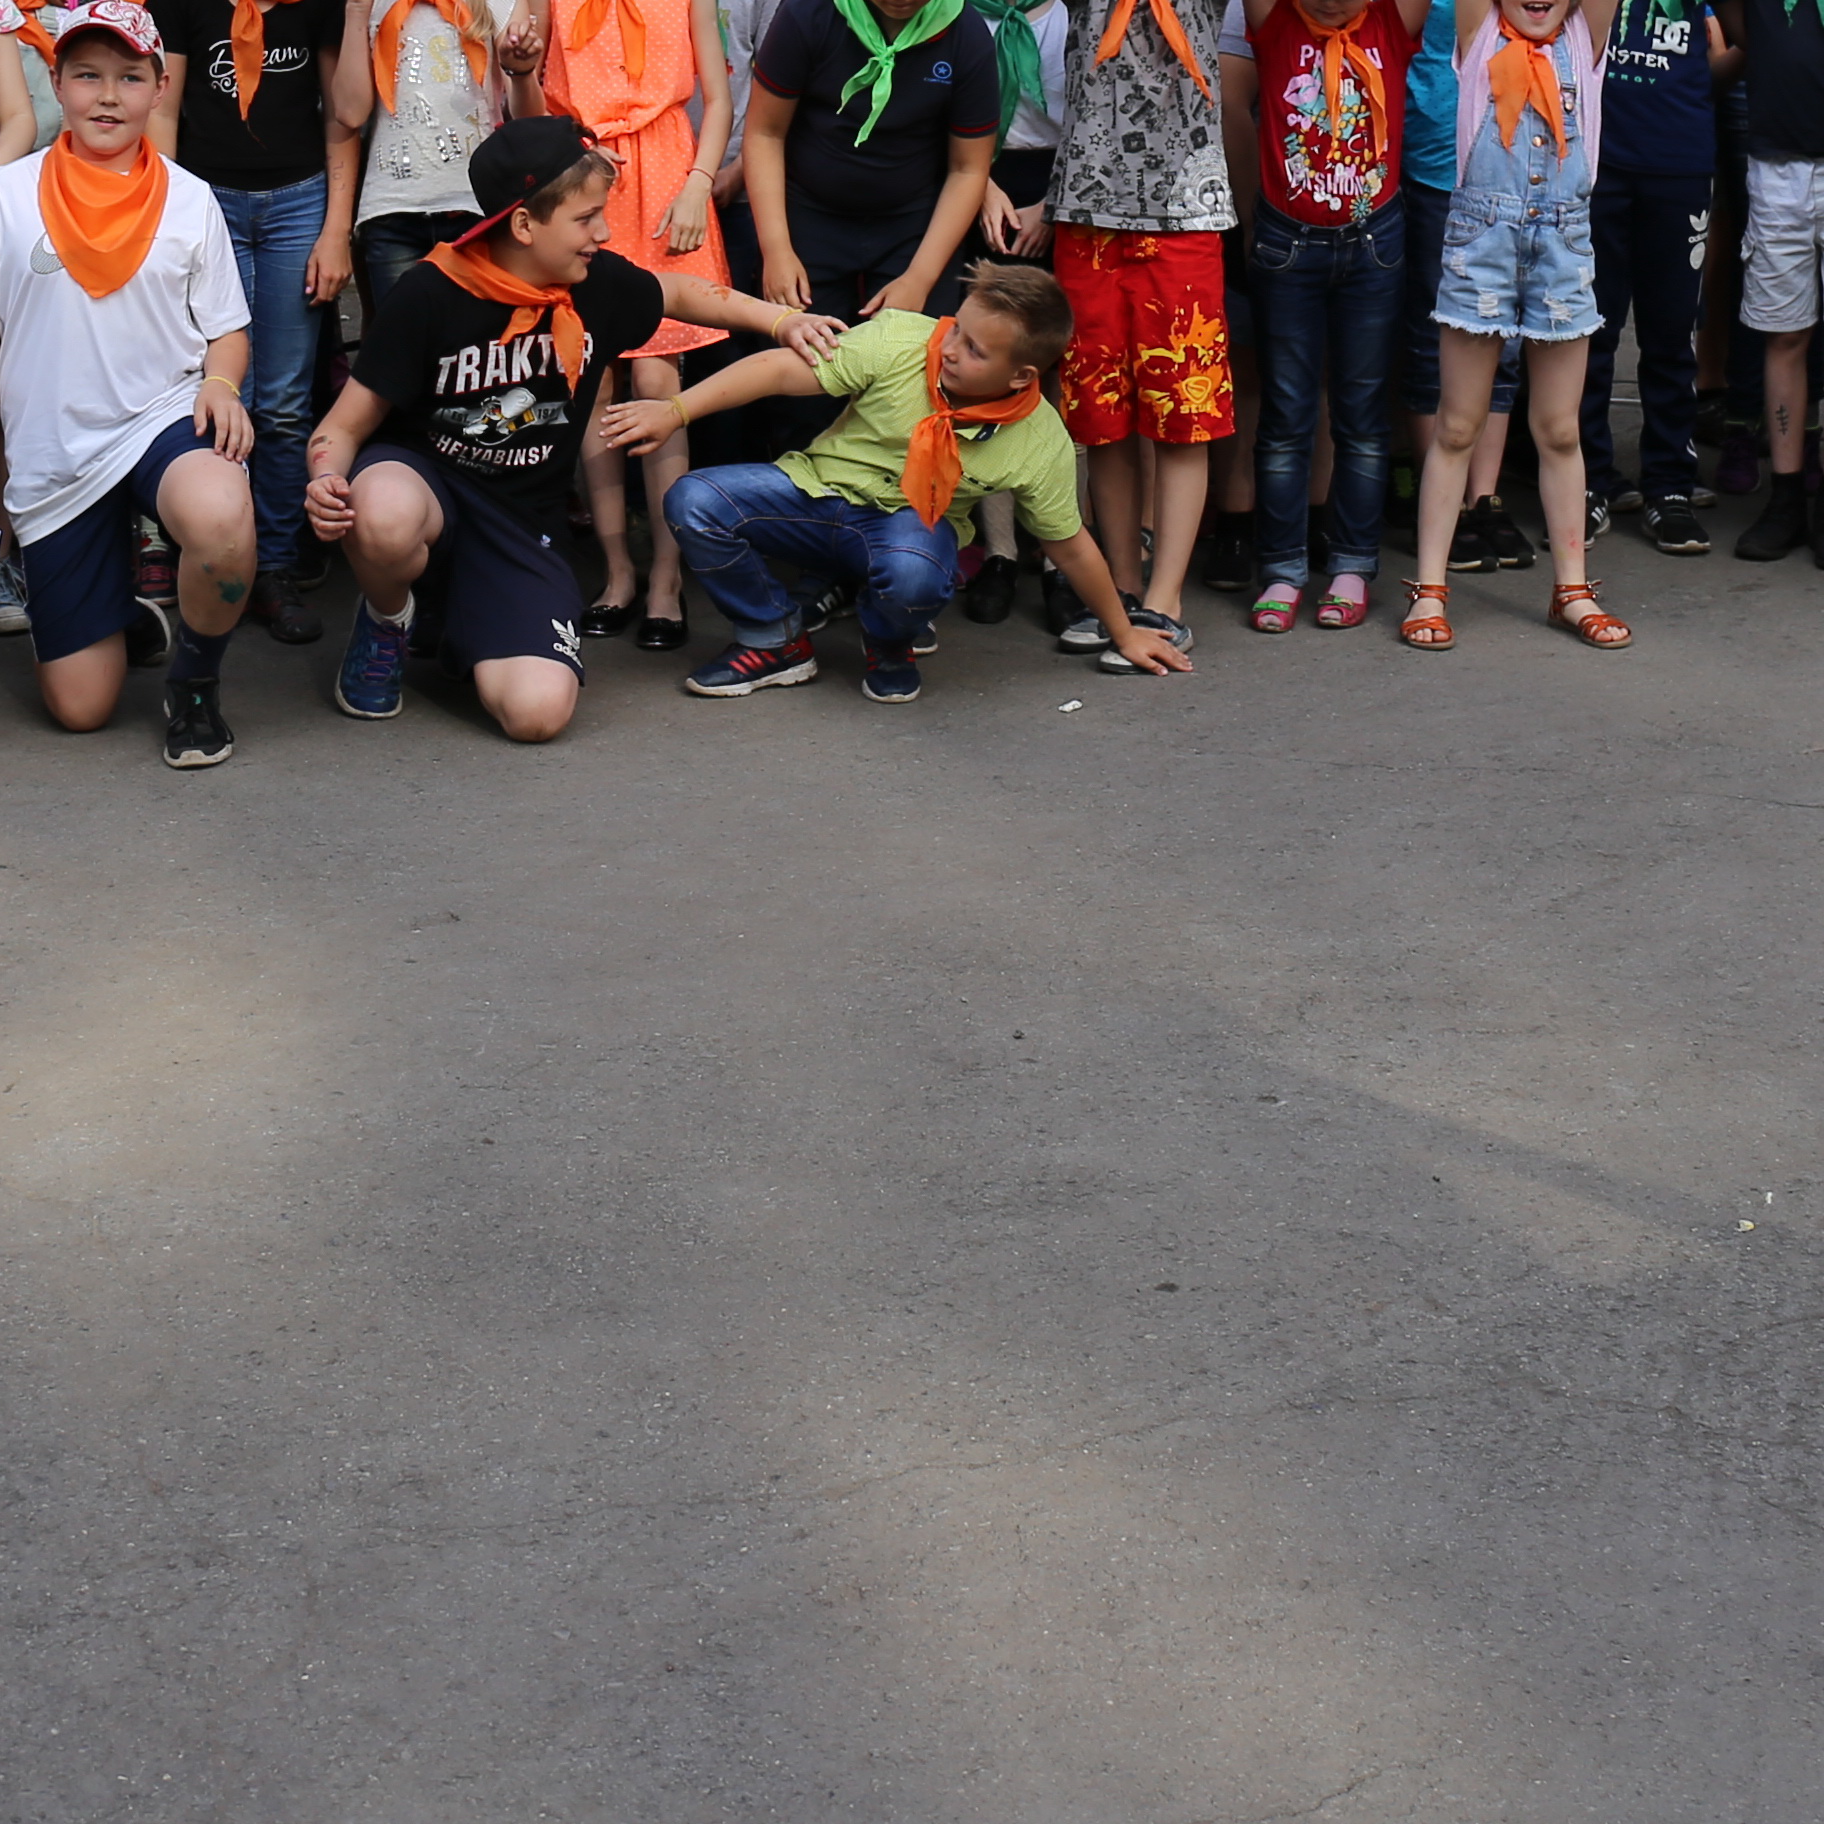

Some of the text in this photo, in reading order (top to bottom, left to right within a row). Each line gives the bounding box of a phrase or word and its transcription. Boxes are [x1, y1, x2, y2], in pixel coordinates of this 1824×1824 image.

[209, 39, 310, 78] Deam
[1606, 45, 1671, 71] NSTER
[1607, 71, 1657, 85] ERGY
[434, 331, 595, 395] TRAKTR
